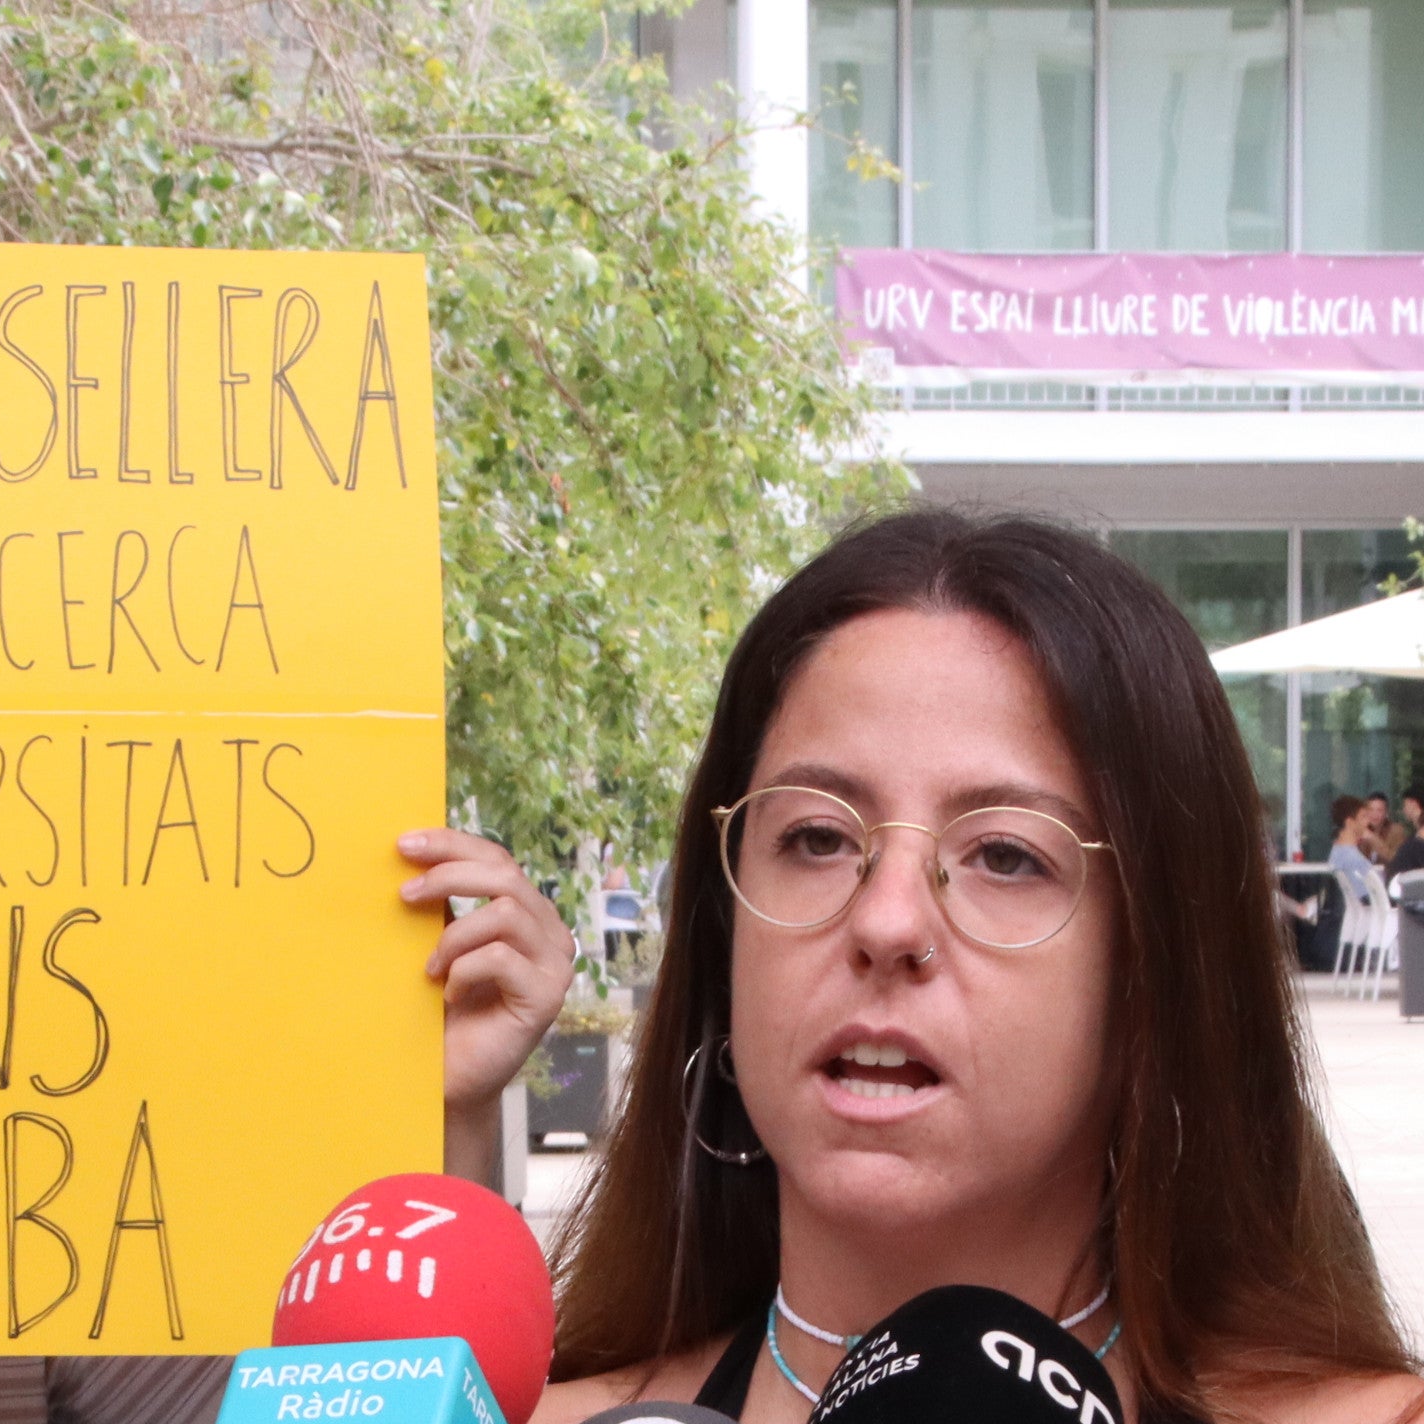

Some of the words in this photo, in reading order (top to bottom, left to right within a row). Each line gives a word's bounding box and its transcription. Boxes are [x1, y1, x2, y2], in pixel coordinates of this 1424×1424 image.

[863, 283, 933, 331] URV
[950, 288, 1034, 333] ESPAI
[1052, 292, 1158, 337] LLIURE
[1173, 293, 1210, 335] DE
[238, 1356, 444, 1389] TARRAGONA
[277, 1388, 384, 1421] Ràdio
